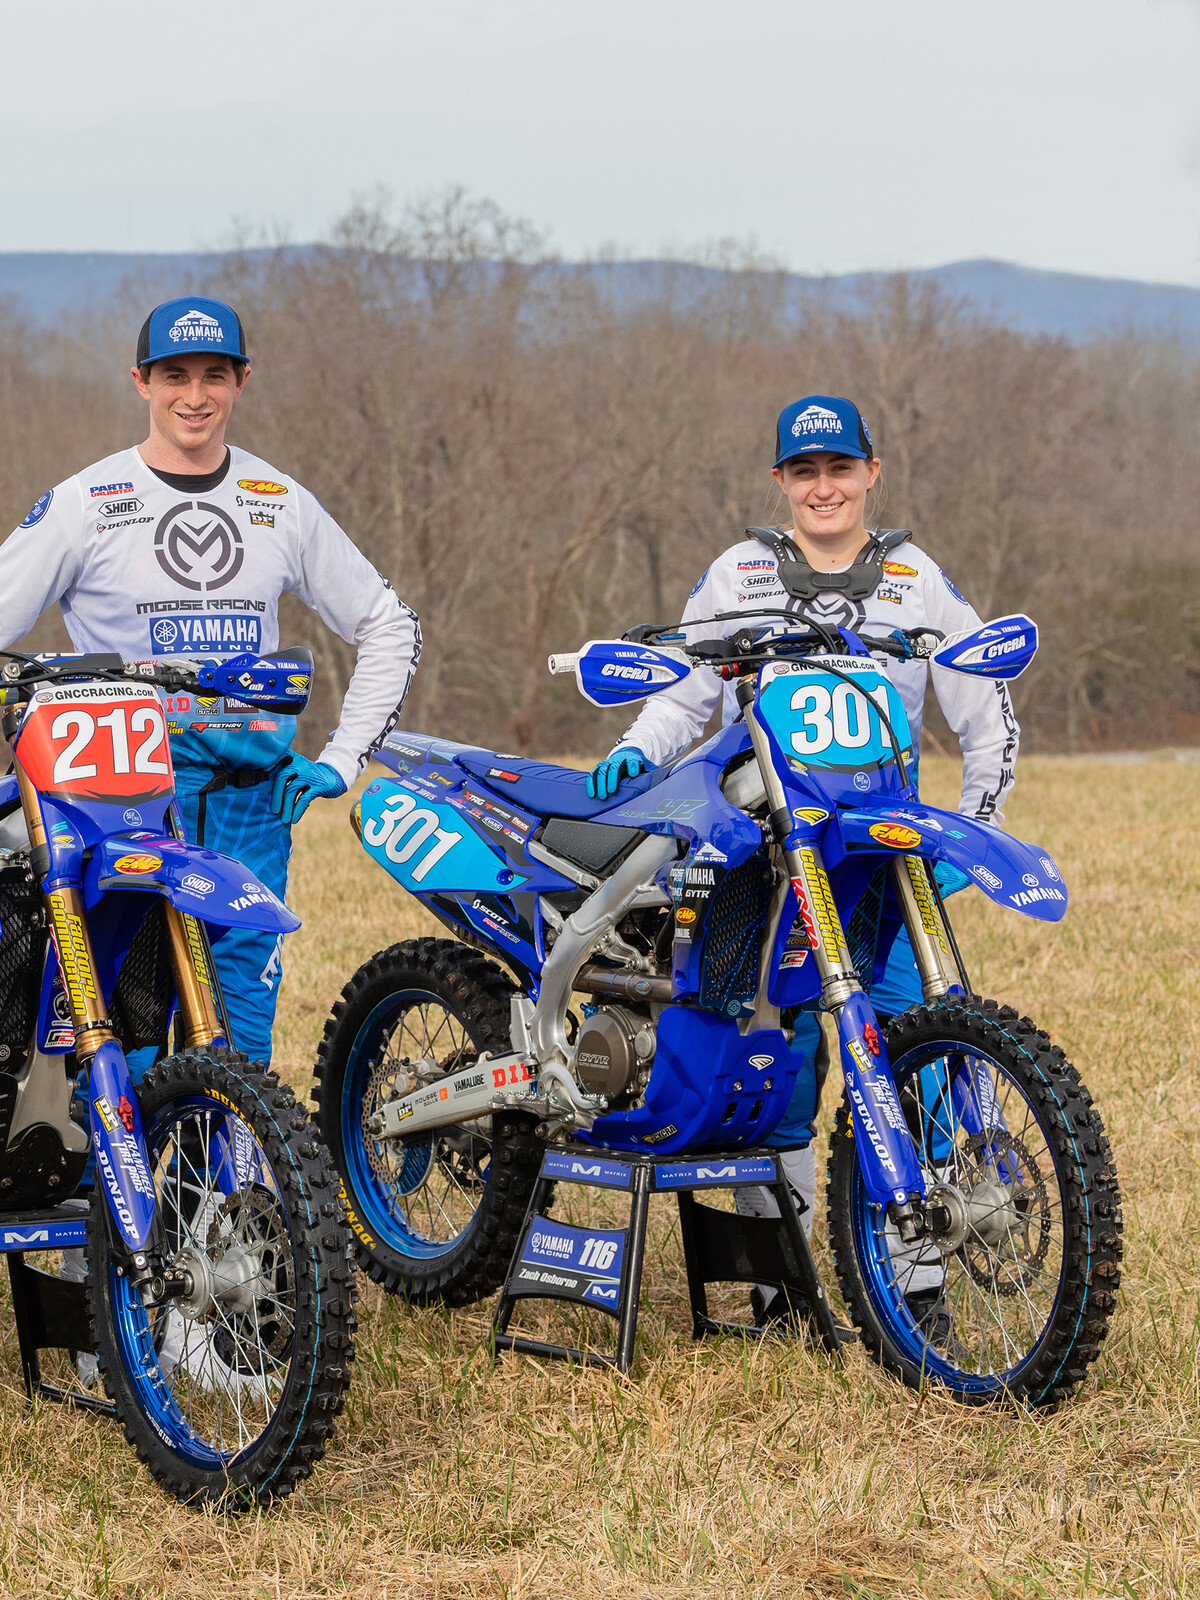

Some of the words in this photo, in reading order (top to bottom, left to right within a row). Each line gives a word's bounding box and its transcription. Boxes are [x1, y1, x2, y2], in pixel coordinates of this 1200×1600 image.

[181, 325, 225, 339] YAMAHA
[801, 418, 843, 431] YAMAHA
[794, 428, 841, 438] RACING
[89, 481, 134, 493] PARTS
[90, 488, 135, 498] UNLIMITED
[238, 480, 288, 495] FMF
[104, 501, 138, 514] SHOEI
[244, 499, 287, 511] SCOTT
[106, 516, 155, 531] DUNLOP
[737, 559, 775, 568] PARTS
[746, 576, 776, 586] SHOEI
[747, 589, 788, 600] DUNLOP
[206, 599, 266, 613] RACING
[178, 618, 258, 643] YAMAHA
[1000, 624, 1022, 634] YAMAHA
[987, 634, 1026, 659] CYCRA
[614, 651, 638, 659] YAMAHA
[277, 662, 299, 670] YAMAHA
[601, 663, 650, 681] CYCRA
[54, 686, 155, 701] GNCCRACING.COM
[789, 682, 894, 756] 301
[50, 707, 170, 785] 212
[383, 739, 422, 758] DUNLOP
[463, 791, 486, 806] XTRIG
[362, 793, 465, 884] 301
[508, 831, 526, 845] SIDI
[869, 825, 923, 844] FMF
[112, 856, 164, 872] FMF
[183, 875, 213, 893] SHOEI
[685, 867, 716, 886] YAMAHA
[976, 866, 1001, 889] SHOEI
[685, 889, 710, 899] GYTR
[1008, 887, 1066, 908] YAMAHA
[478, 905, 510, 926] SCOTT
[676, 910, 697, 922] FMF
[483, 918, 521, 944] PROFILTER
[578, 1051, 610, 1066] GYTR
[851, 1040, 874, 1070] DP
[453, 1074, 485, 1093] YAMALUBE
[398, 1105, 413, 1117] DP
[876, 1073, 909, 1136] TRAMMELL
[99, 1098, 120, 1128] DP
[653, 1124, 679, 1142] CYCRA
[851, 1089, 897, 1174] DUNLOP
[122, 1133, 156, 1200] TRAMMELL
[548, 1161, 569, 1169] MATRIX
[604, 1170, 627, 1178] MATRIX
[661, 1171, 693, 1179] MATRIX
[741, 1166, 772, 1174] MATRIX
[98, 1150, 141, 1240] DUNLOP
[541, 1233, 574, 1255] YAMAHA
[532, 1247, 570, 1260] RACING
[578, 1238, 618, 1270] 116
[518, 1268, 540, 1283] Zach
[539, 1272, 578, 1289] Osborne
